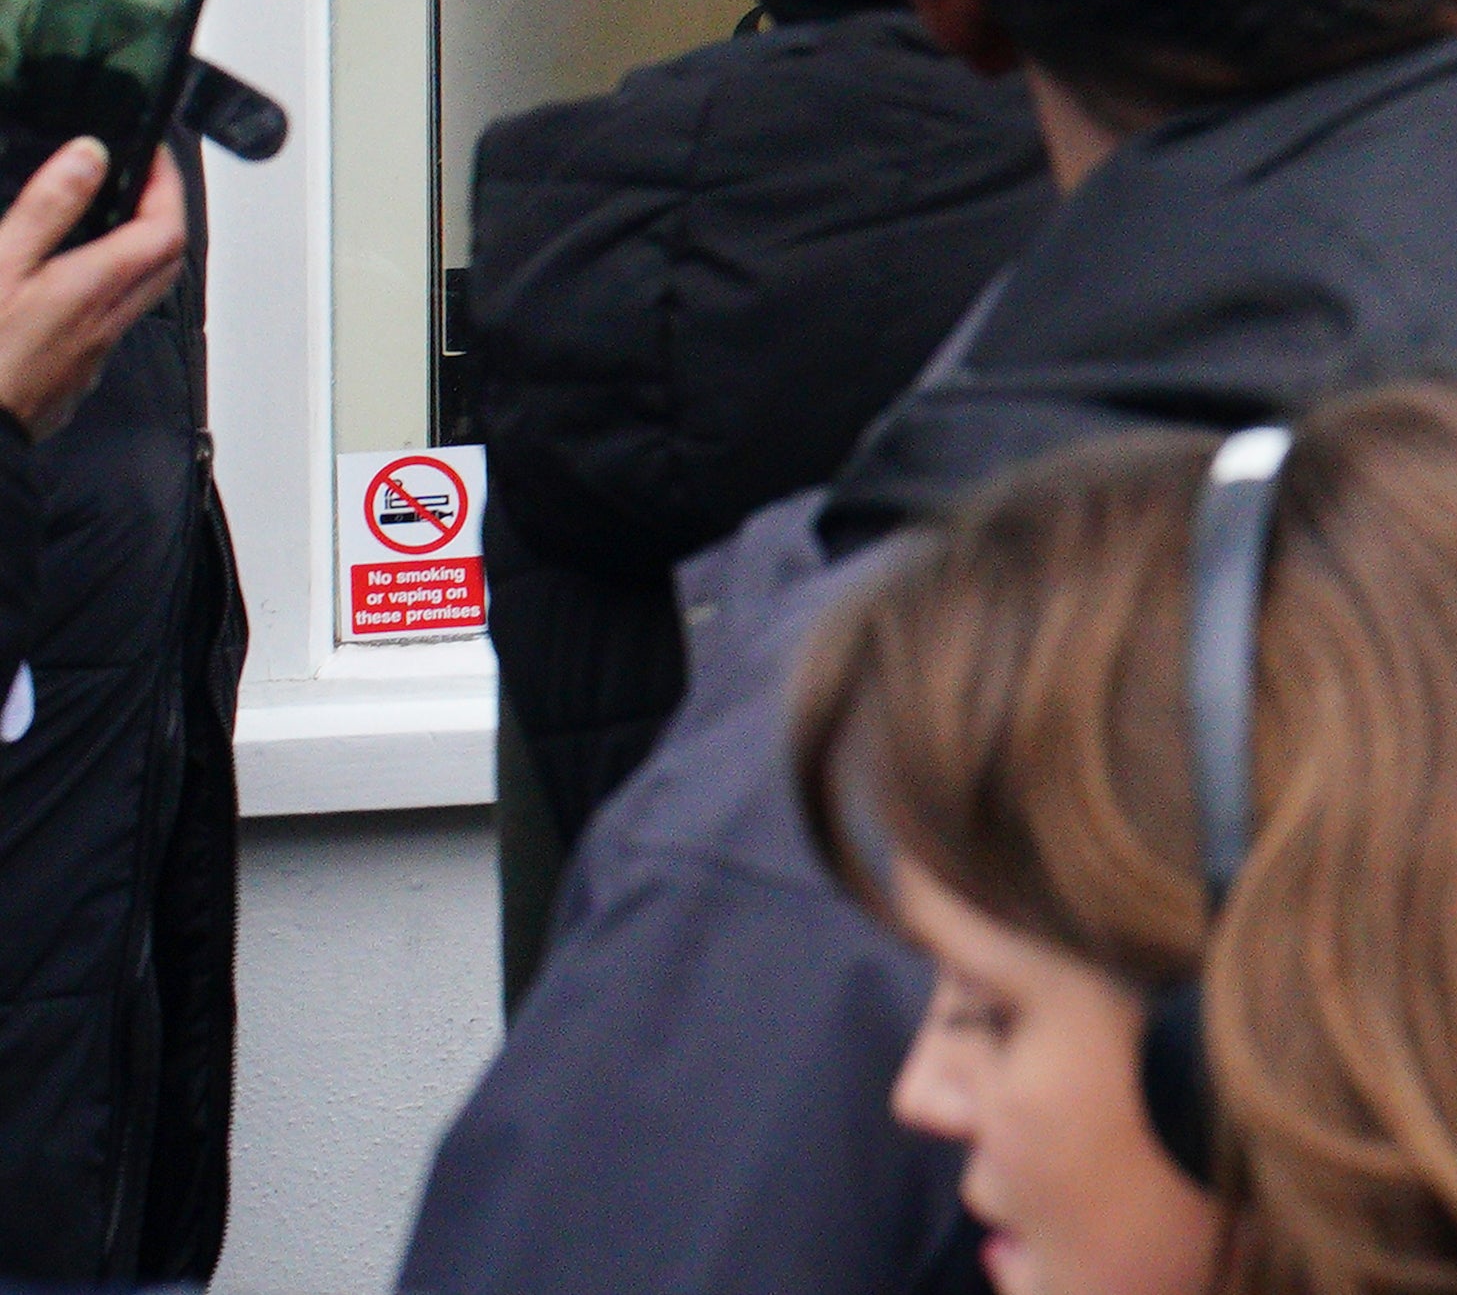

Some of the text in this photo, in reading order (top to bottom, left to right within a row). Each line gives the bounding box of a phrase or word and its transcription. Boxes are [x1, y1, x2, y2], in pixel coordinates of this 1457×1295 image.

[368, 567, 465, 585] No smoking
[366, 587, 467, 606] or vaping on
[355, 605, 480, 625] these premises
